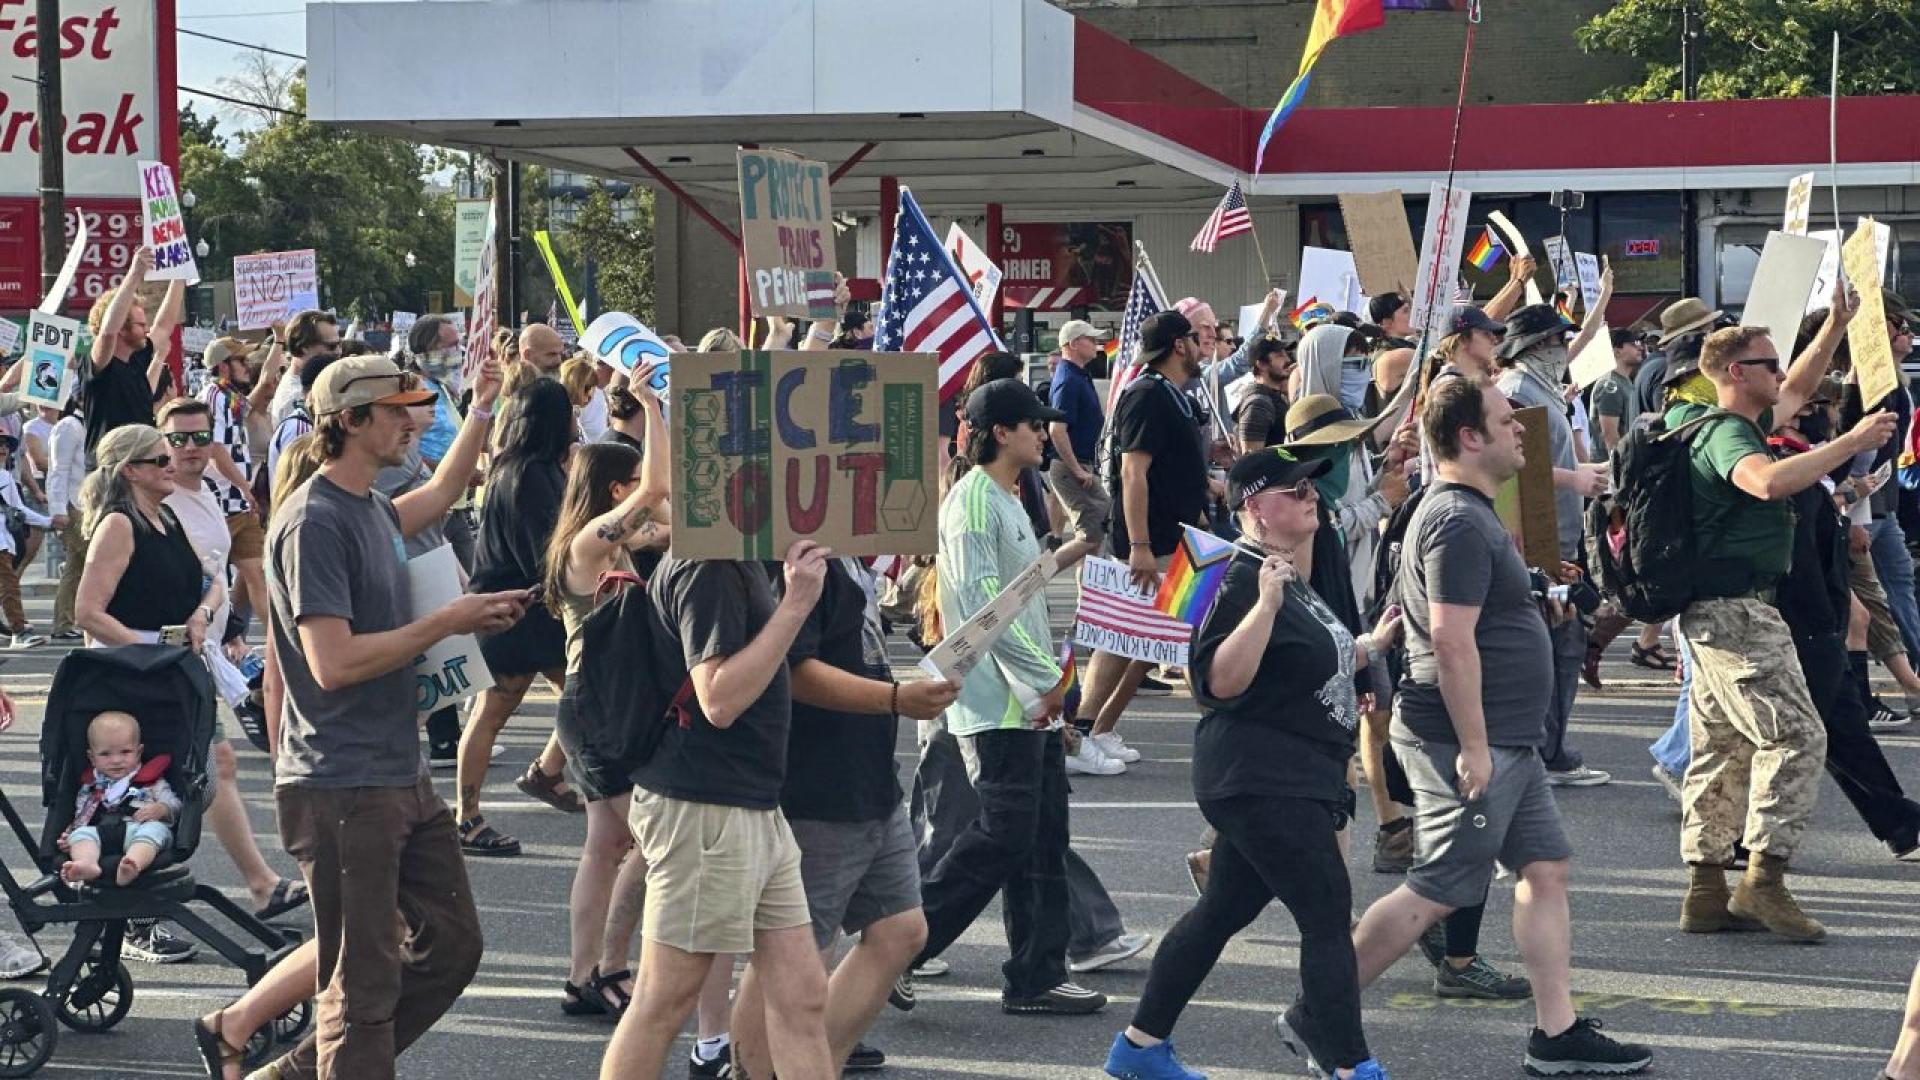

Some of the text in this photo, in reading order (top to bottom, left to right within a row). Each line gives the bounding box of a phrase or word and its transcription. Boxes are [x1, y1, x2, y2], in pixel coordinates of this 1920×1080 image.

[251, 272, 296, 303] NOT
[33, 322, 73, 348] FDT
[711, 363, 881, 456] ICE
[725, 453, 888, 537] OUT
[1087, 561, 1118, 589] WELL
[1154, 642, 1177, 664] HAD
